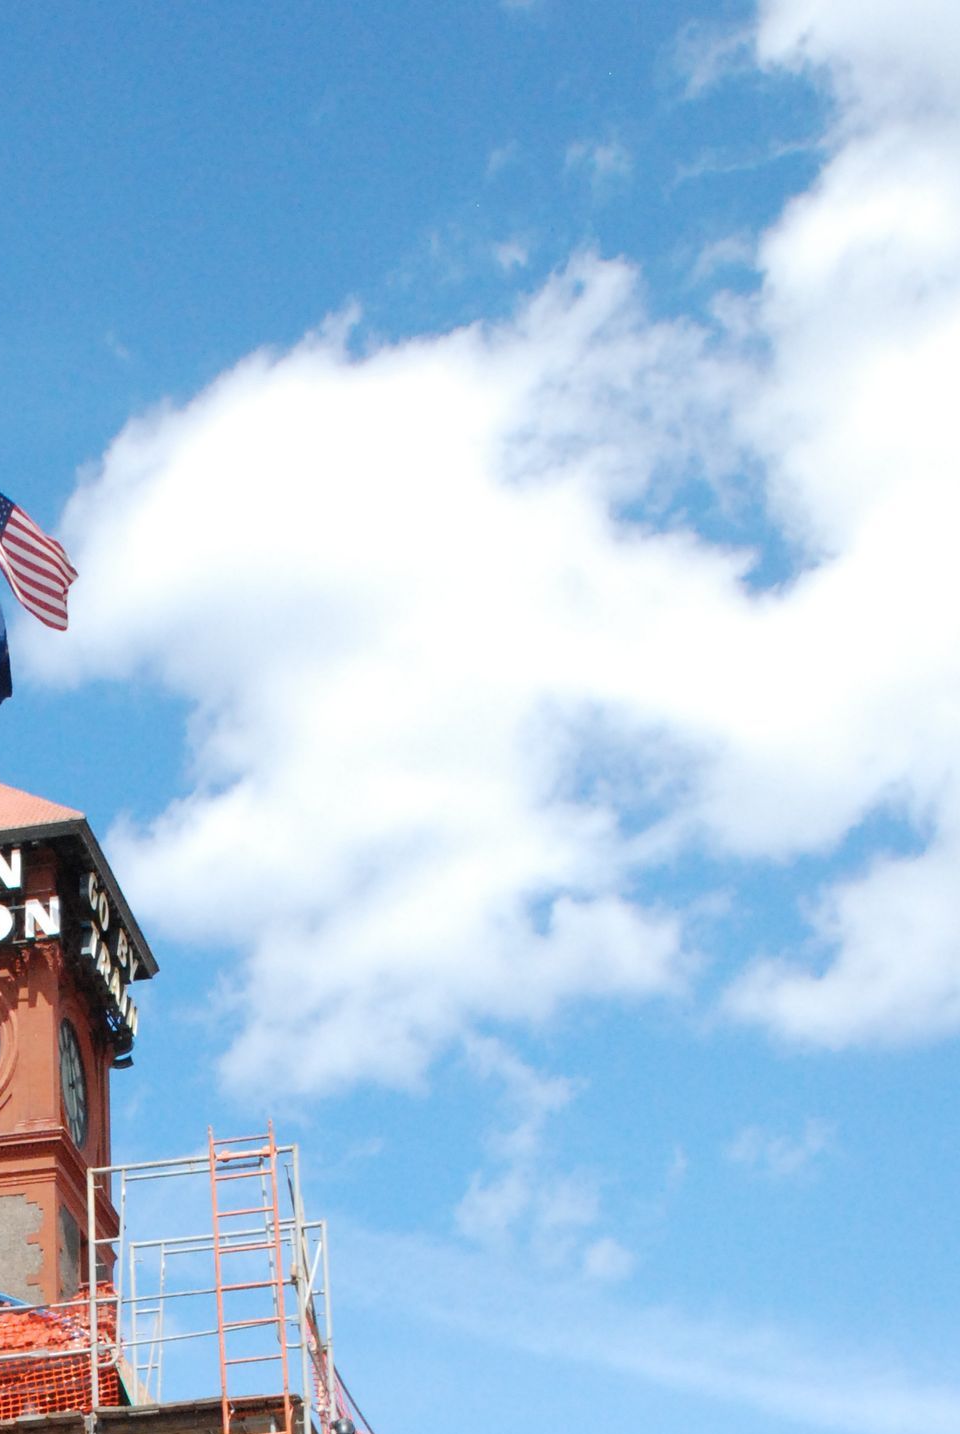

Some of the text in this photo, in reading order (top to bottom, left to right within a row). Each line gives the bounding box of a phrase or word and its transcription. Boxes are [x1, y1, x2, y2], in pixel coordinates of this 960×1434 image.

[88, 871, 139, 983] GO BY
[88, 919, 139, 1038] TRAIN
